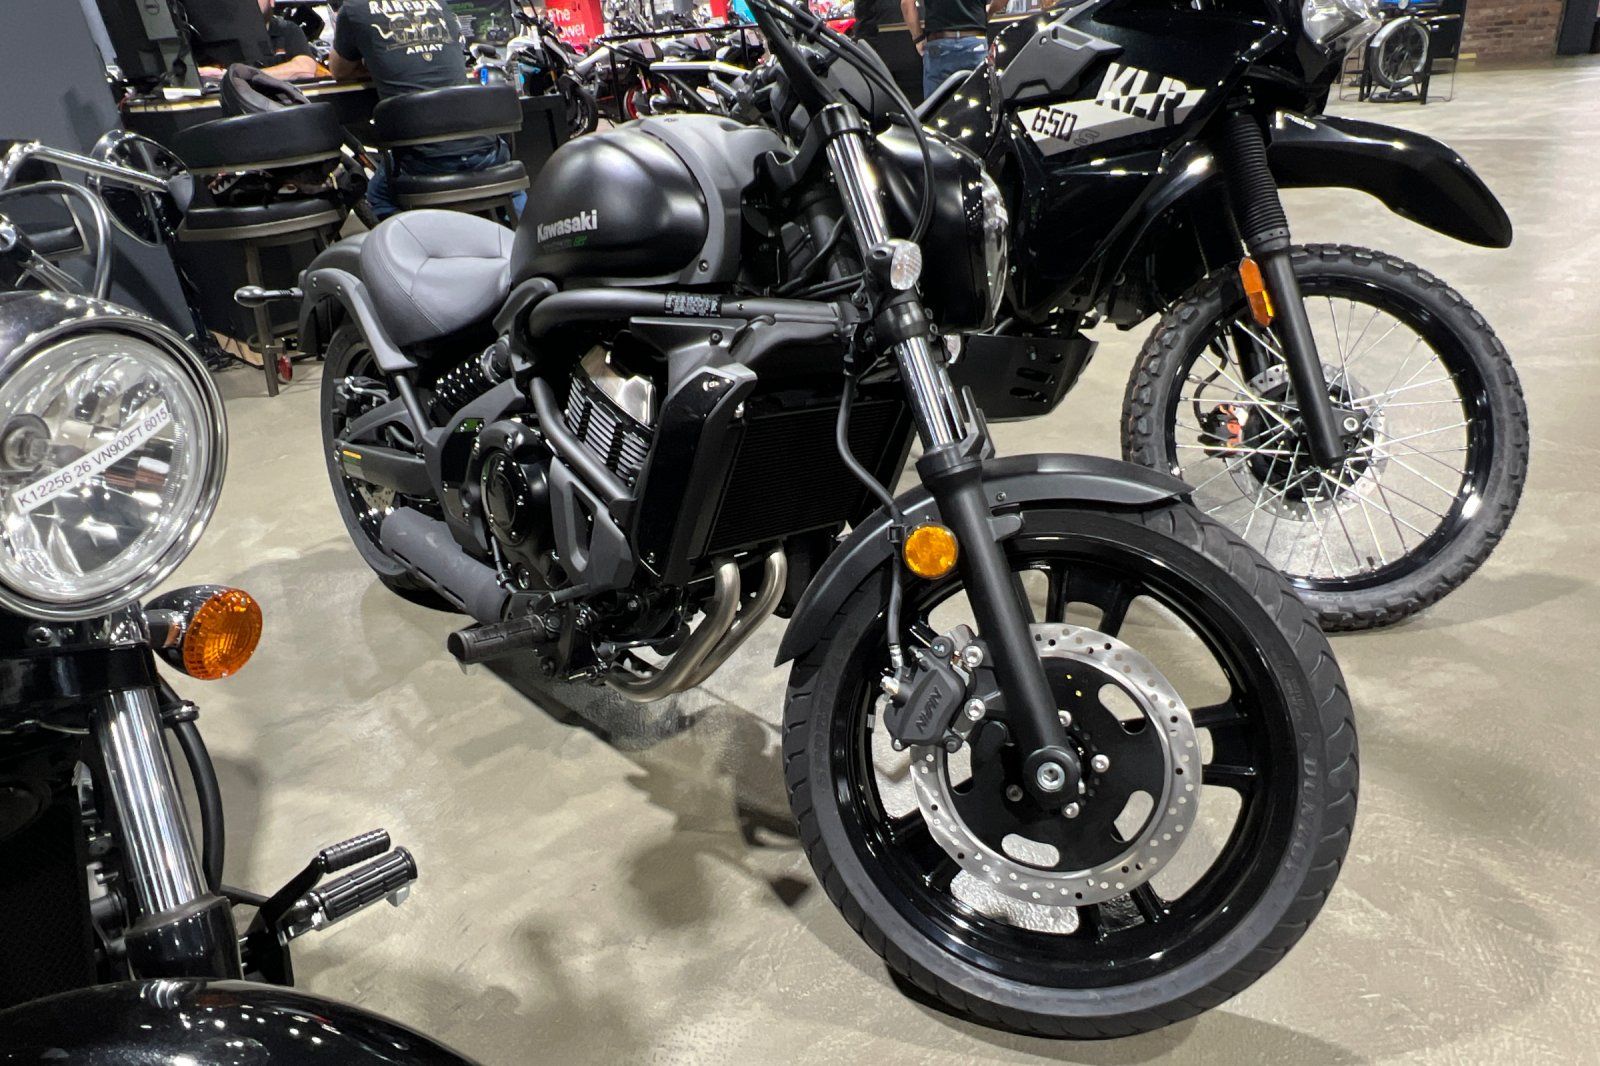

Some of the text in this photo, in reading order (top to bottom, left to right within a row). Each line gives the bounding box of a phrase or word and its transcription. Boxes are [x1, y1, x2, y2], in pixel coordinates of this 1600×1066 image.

[406, 43, 444, 55] ARIAT
[1095, 62, 1188, 127] KLR
[1031, 106, 1079, 142] 650
[536, 209, 598, 243] Kawasaki
[17, 407, 168, 508] K12256 26 VN900FT 6015
